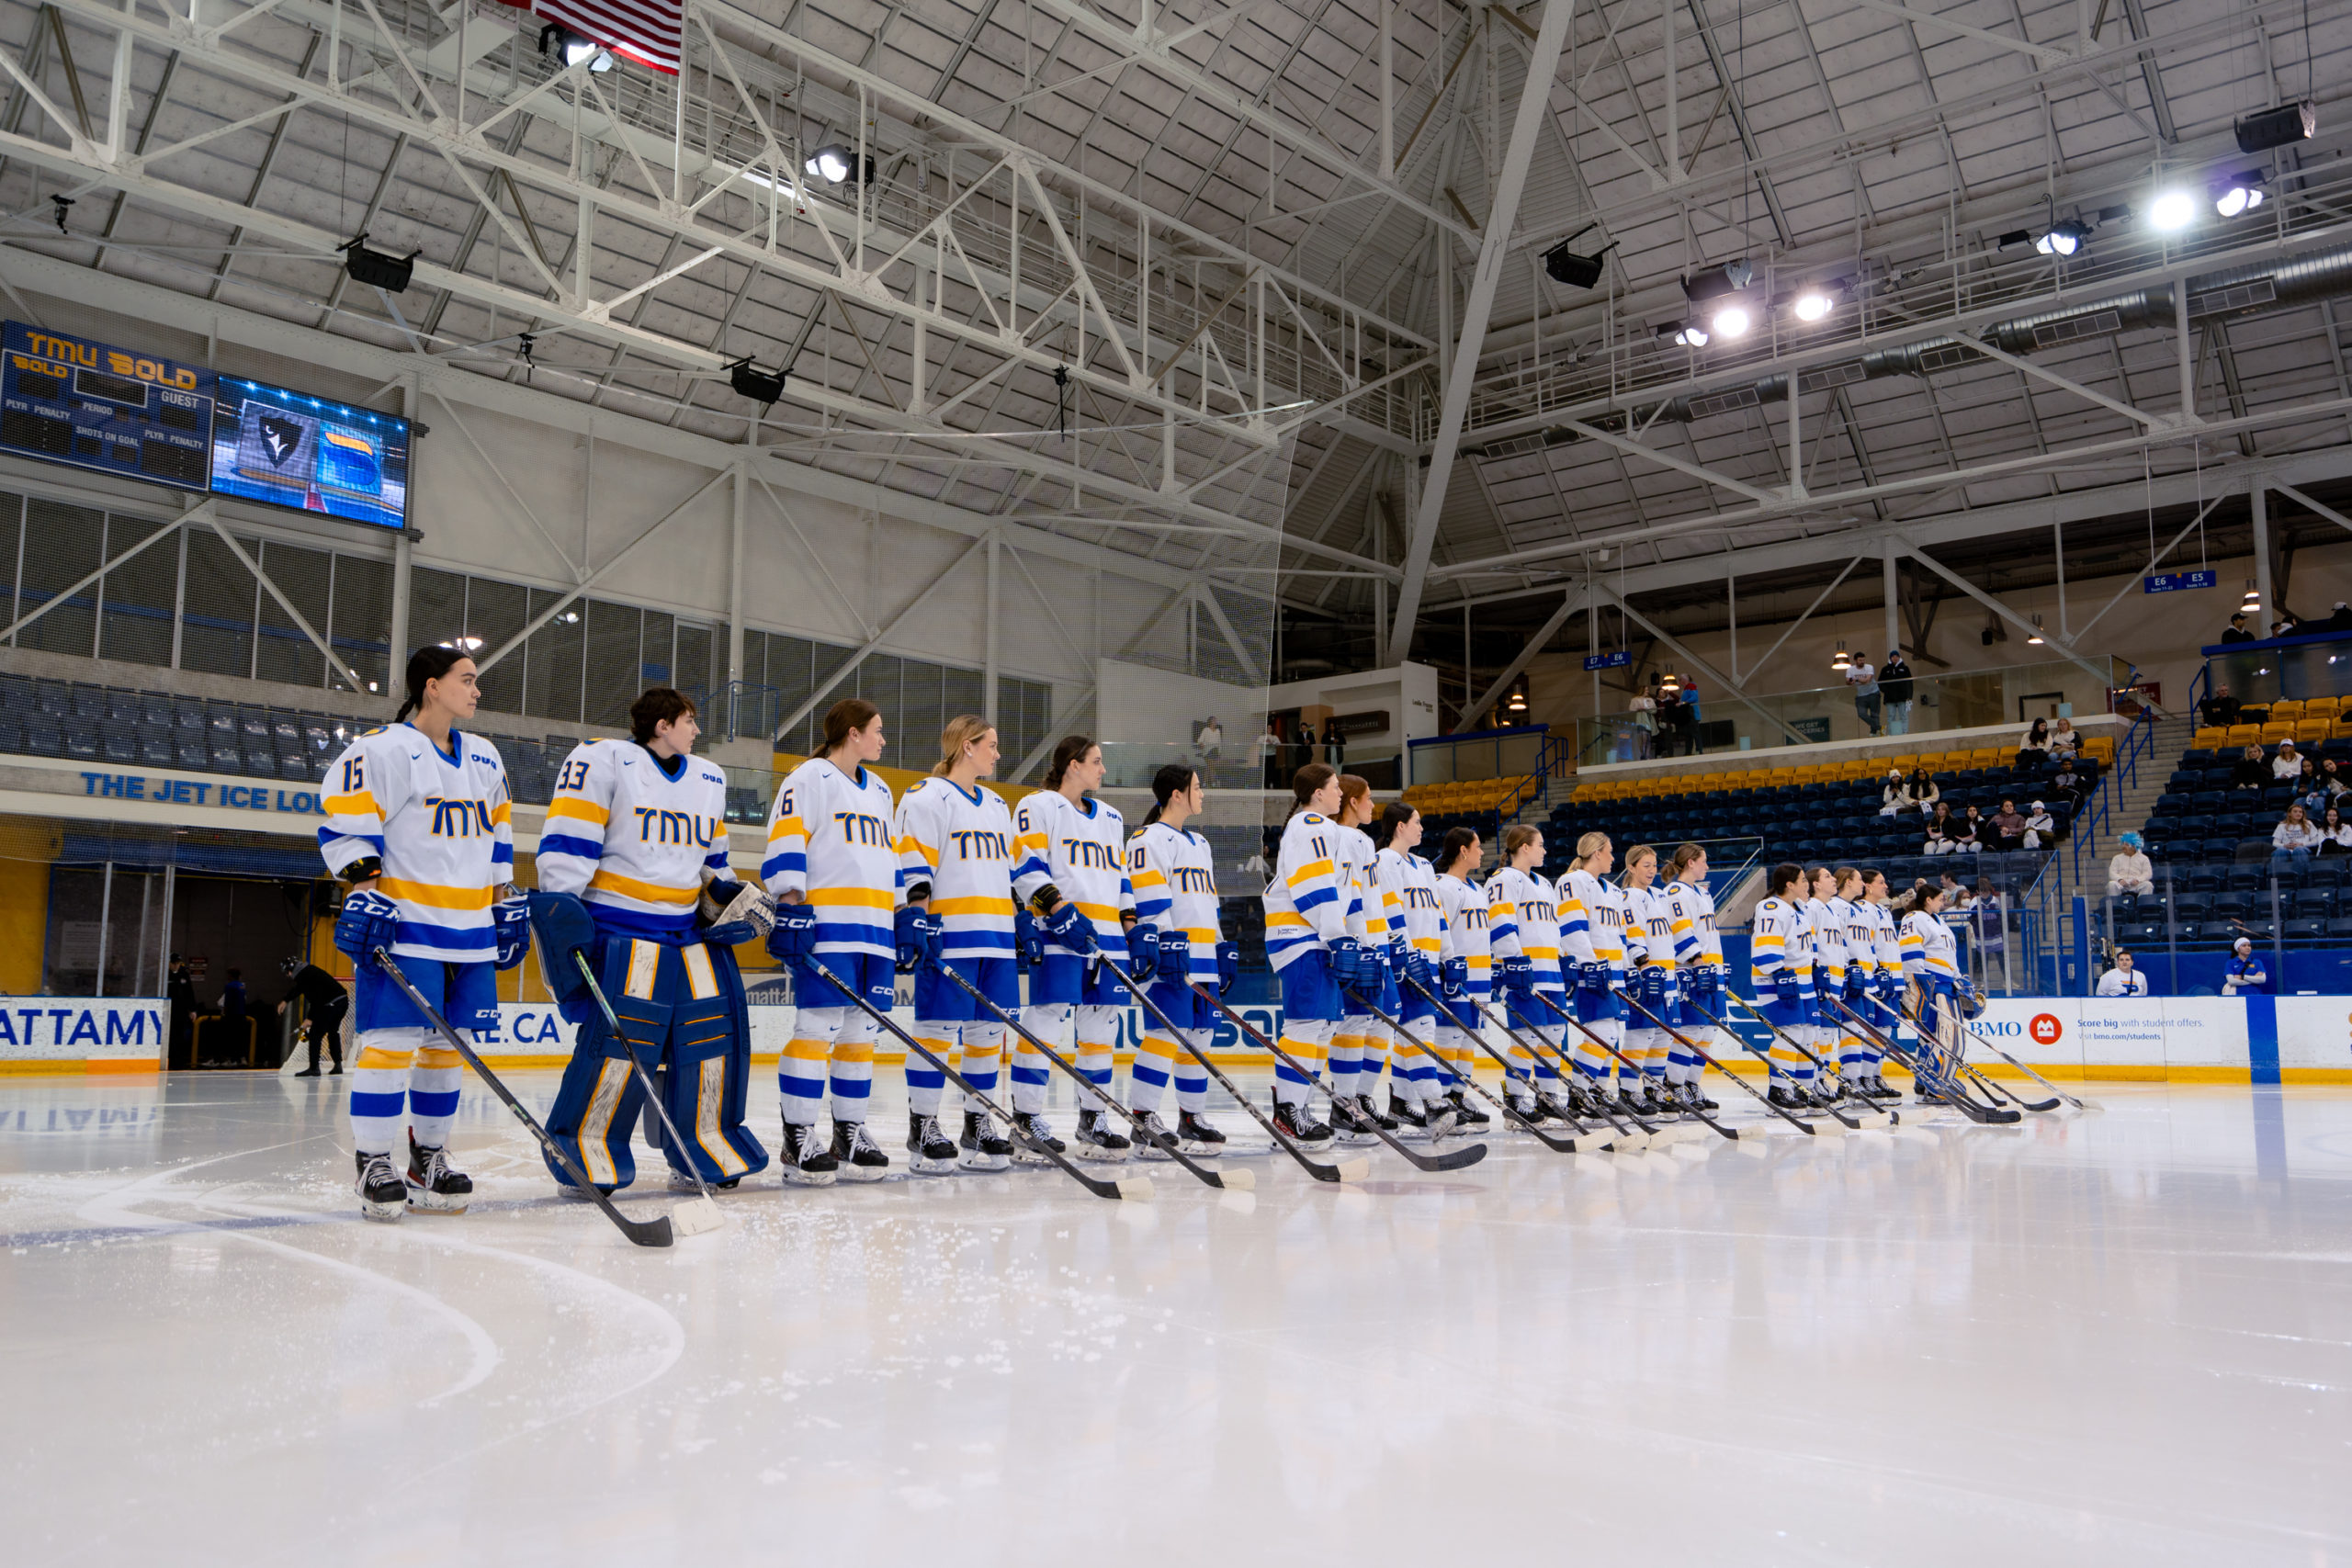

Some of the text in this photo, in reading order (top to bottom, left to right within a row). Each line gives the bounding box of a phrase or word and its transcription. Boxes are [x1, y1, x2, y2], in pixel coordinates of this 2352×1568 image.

[12, 355, 67, 378] BOLD
[27, 332, 197, 389] TMU BOLD
[6, 399, 71, 420] PLYR PENALTY
[83, 401, 113, 415] PERIOD
[162, 391, 199, 409] GUEST
[75, 425, 139, 447] SHOTS ON GOAL
[145, 429, 203, 449] PLYR PENALTY
[2154, 577, 2166, 586] E6
[2191, 573, 2204, 582] E5
[336, 755, 364, 793] 15
[557, 761, 590, 792] 33
[81, 772, 145, 799] THE
[153, 779, 211, 805] JET
[220, 784, 268, 810] ICE
[634, 806, 717, 850] TMU
[1062, 838, 1121, 873] TMU
[1311, 836, 1329, 859] 11
[1487, 883, 1503, 904] 27
[1558, 882, 1574, 902] 19
[1760, 918, 1775, 933] 17
[1901, 921, 1914, 936] 29
[1970, 1021, 2021, 1037] BMO
[2077, 1018, 2205, 1030] Score big with student offers.
[2094, 1033, 2161, 1042] bmo.com/students
